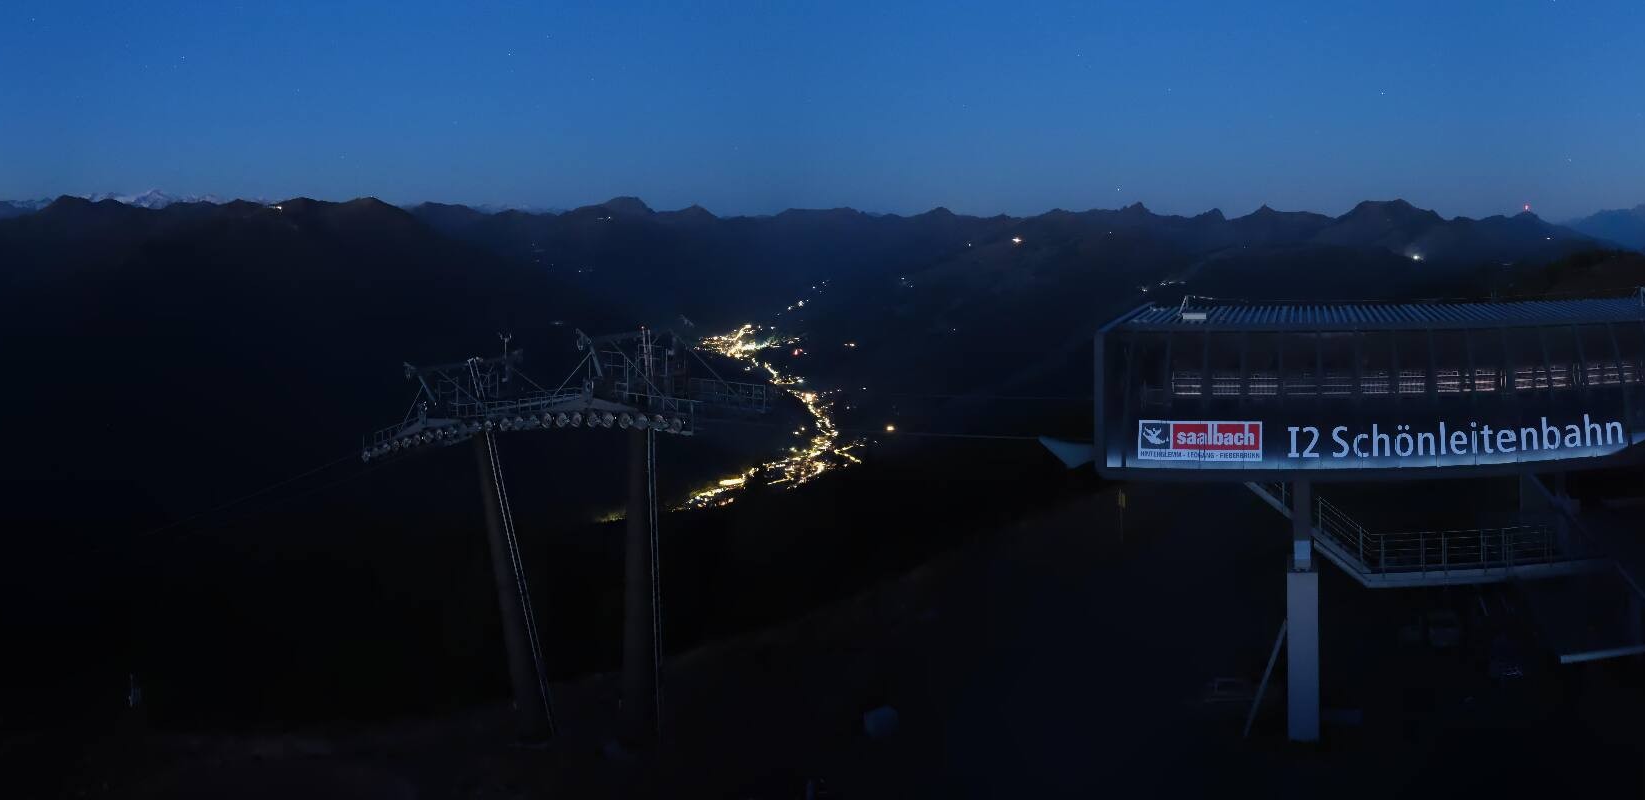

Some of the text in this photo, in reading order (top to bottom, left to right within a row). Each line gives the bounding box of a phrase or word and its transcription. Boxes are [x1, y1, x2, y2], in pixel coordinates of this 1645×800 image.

[1177, 423, 1255, 446] saalbach
[1287, 413, 1624, 458] I2 Schönleitenbahn
